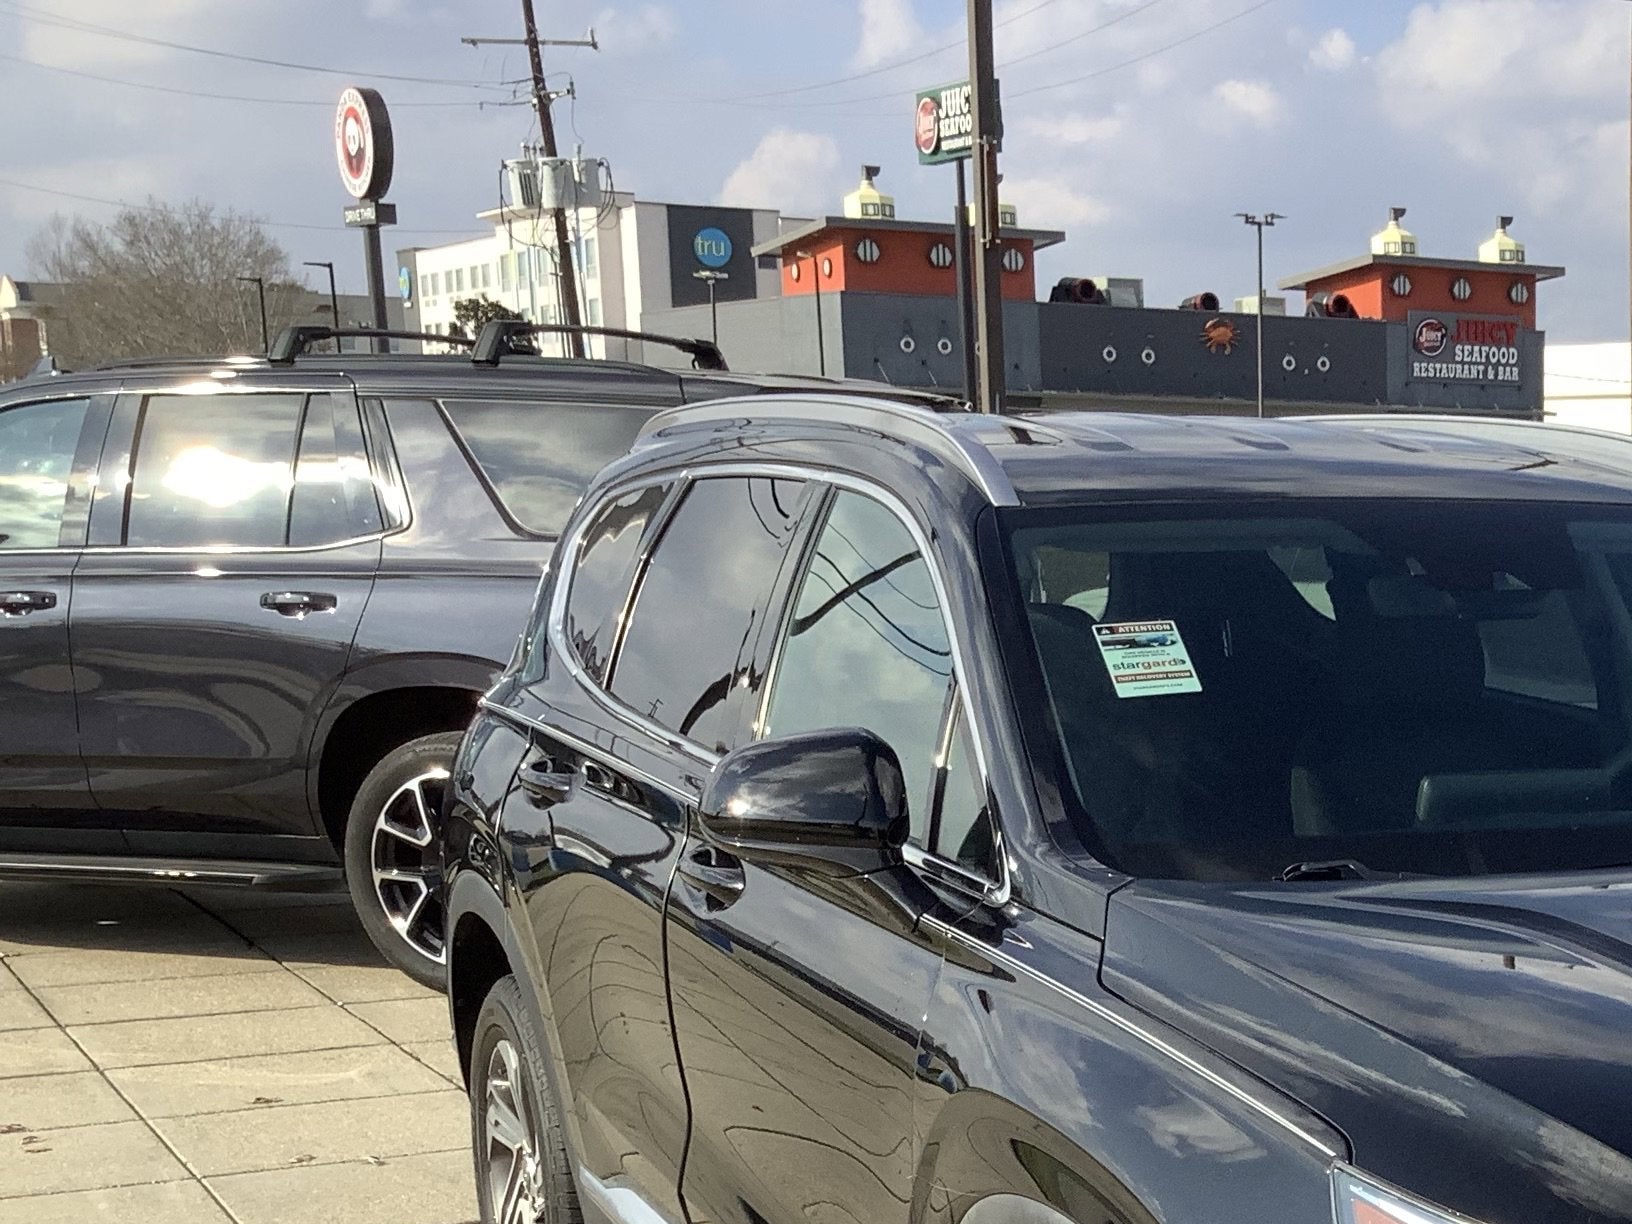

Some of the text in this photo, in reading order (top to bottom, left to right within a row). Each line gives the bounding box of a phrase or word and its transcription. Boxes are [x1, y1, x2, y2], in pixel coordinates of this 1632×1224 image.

[939, 85, 972, 118] JUIC
[940, 114, 973, 138] SEAFOO
[695, 233, 725, 257] tru
[1451, 319, 1518, 347] JUICY
[1455, 344, 1518, 365] SEAFOOD
[1413, 362, 1519, 381] RESTAURANT & BAR
[1118, 623, 1171, 633] ATTENTION
